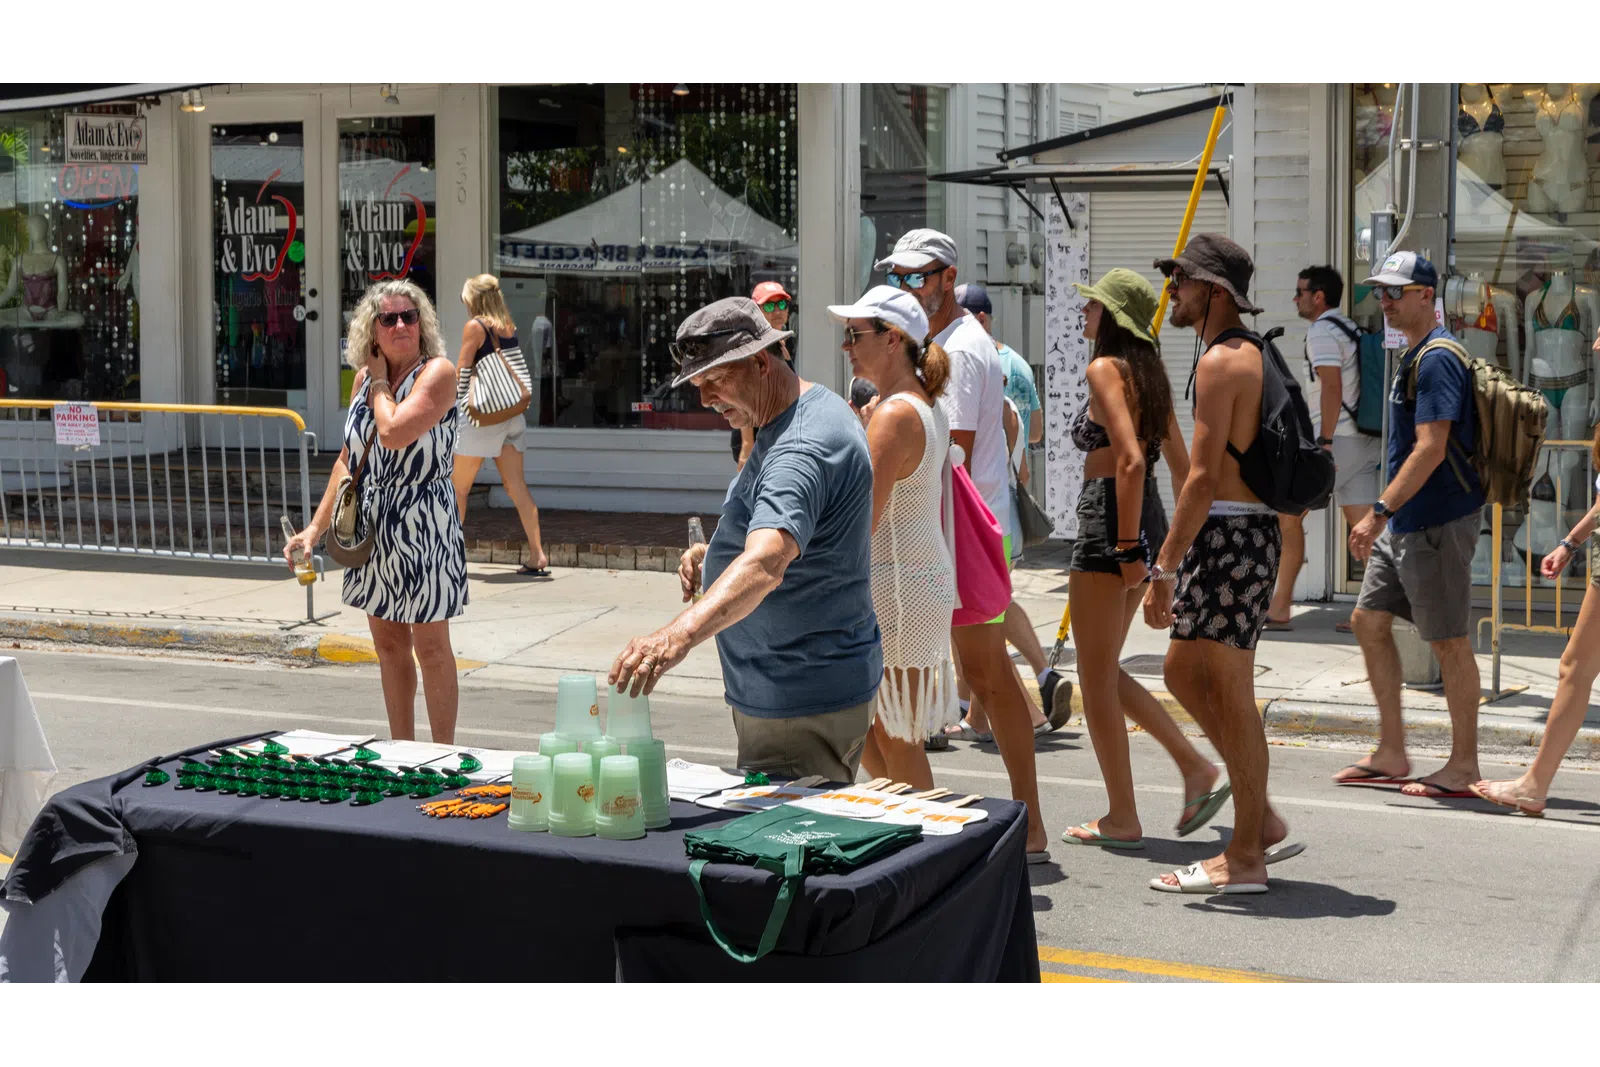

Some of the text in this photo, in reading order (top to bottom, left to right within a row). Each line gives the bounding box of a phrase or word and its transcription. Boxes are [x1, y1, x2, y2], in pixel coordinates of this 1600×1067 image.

[73, 119, 136, 148] Adam & Eve
[70, 150, 99, 162] Novelties,
[58, 163, 131, 201] OPEN
[221, 196, 276, 235] Adam
[347, 195, 405, 232] Adam
[221, 234, 277, 273] & Eve
[346, 232, 405, 272] & Eve
[56, 413, 96, 422] PARKING
[69, 405, 82, 414] NO
